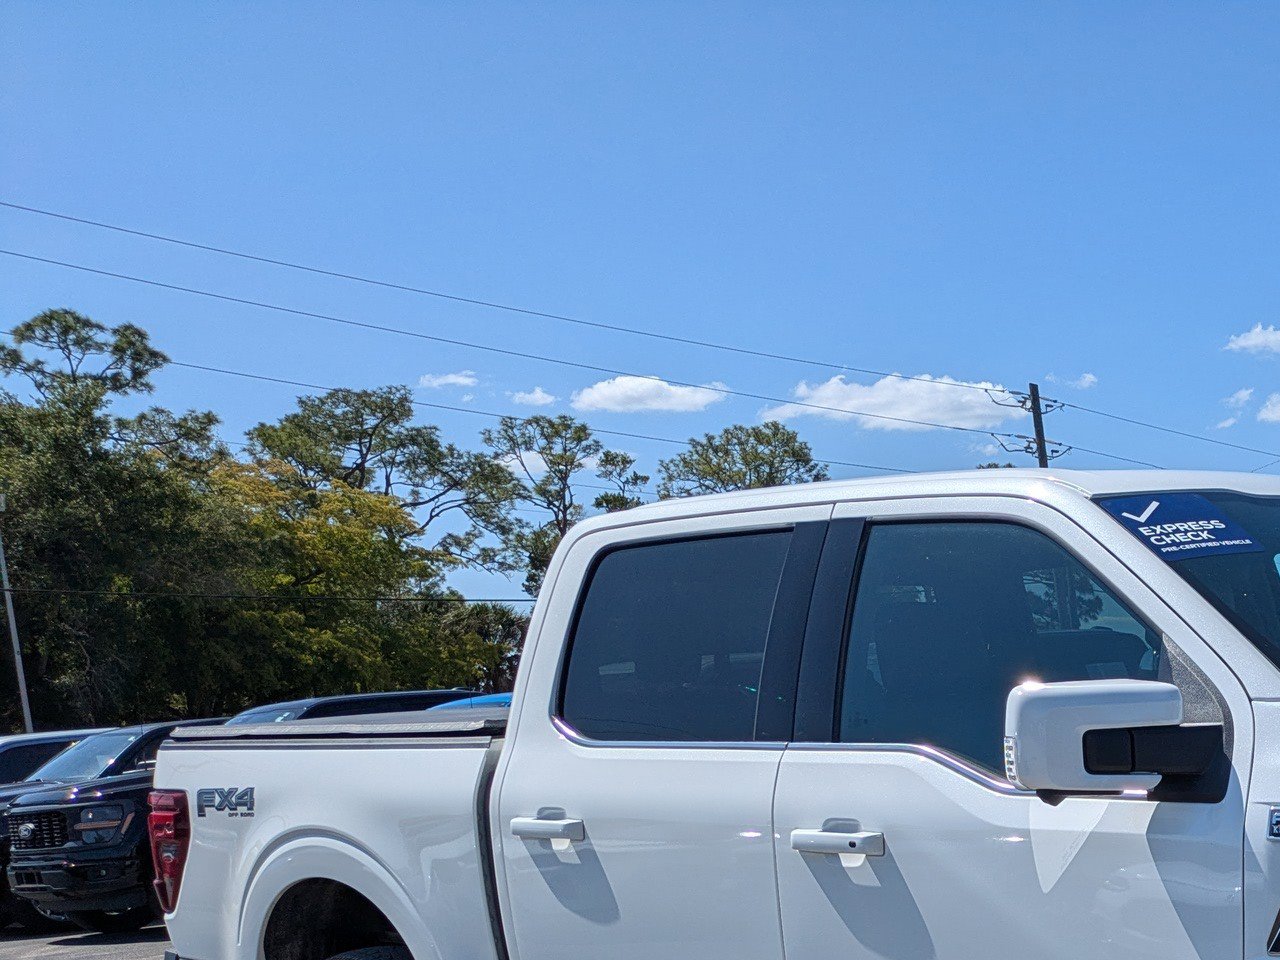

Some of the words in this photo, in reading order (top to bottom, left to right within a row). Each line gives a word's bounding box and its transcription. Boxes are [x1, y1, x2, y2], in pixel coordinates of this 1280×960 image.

[1138, 520, 1226, 537] EXPRESS
[1150, 530, 1216, 546] CHECK
[1161, 542, 1220, 553] PRE-CERTIFIED
[197, 787, 255, 817] FX4
